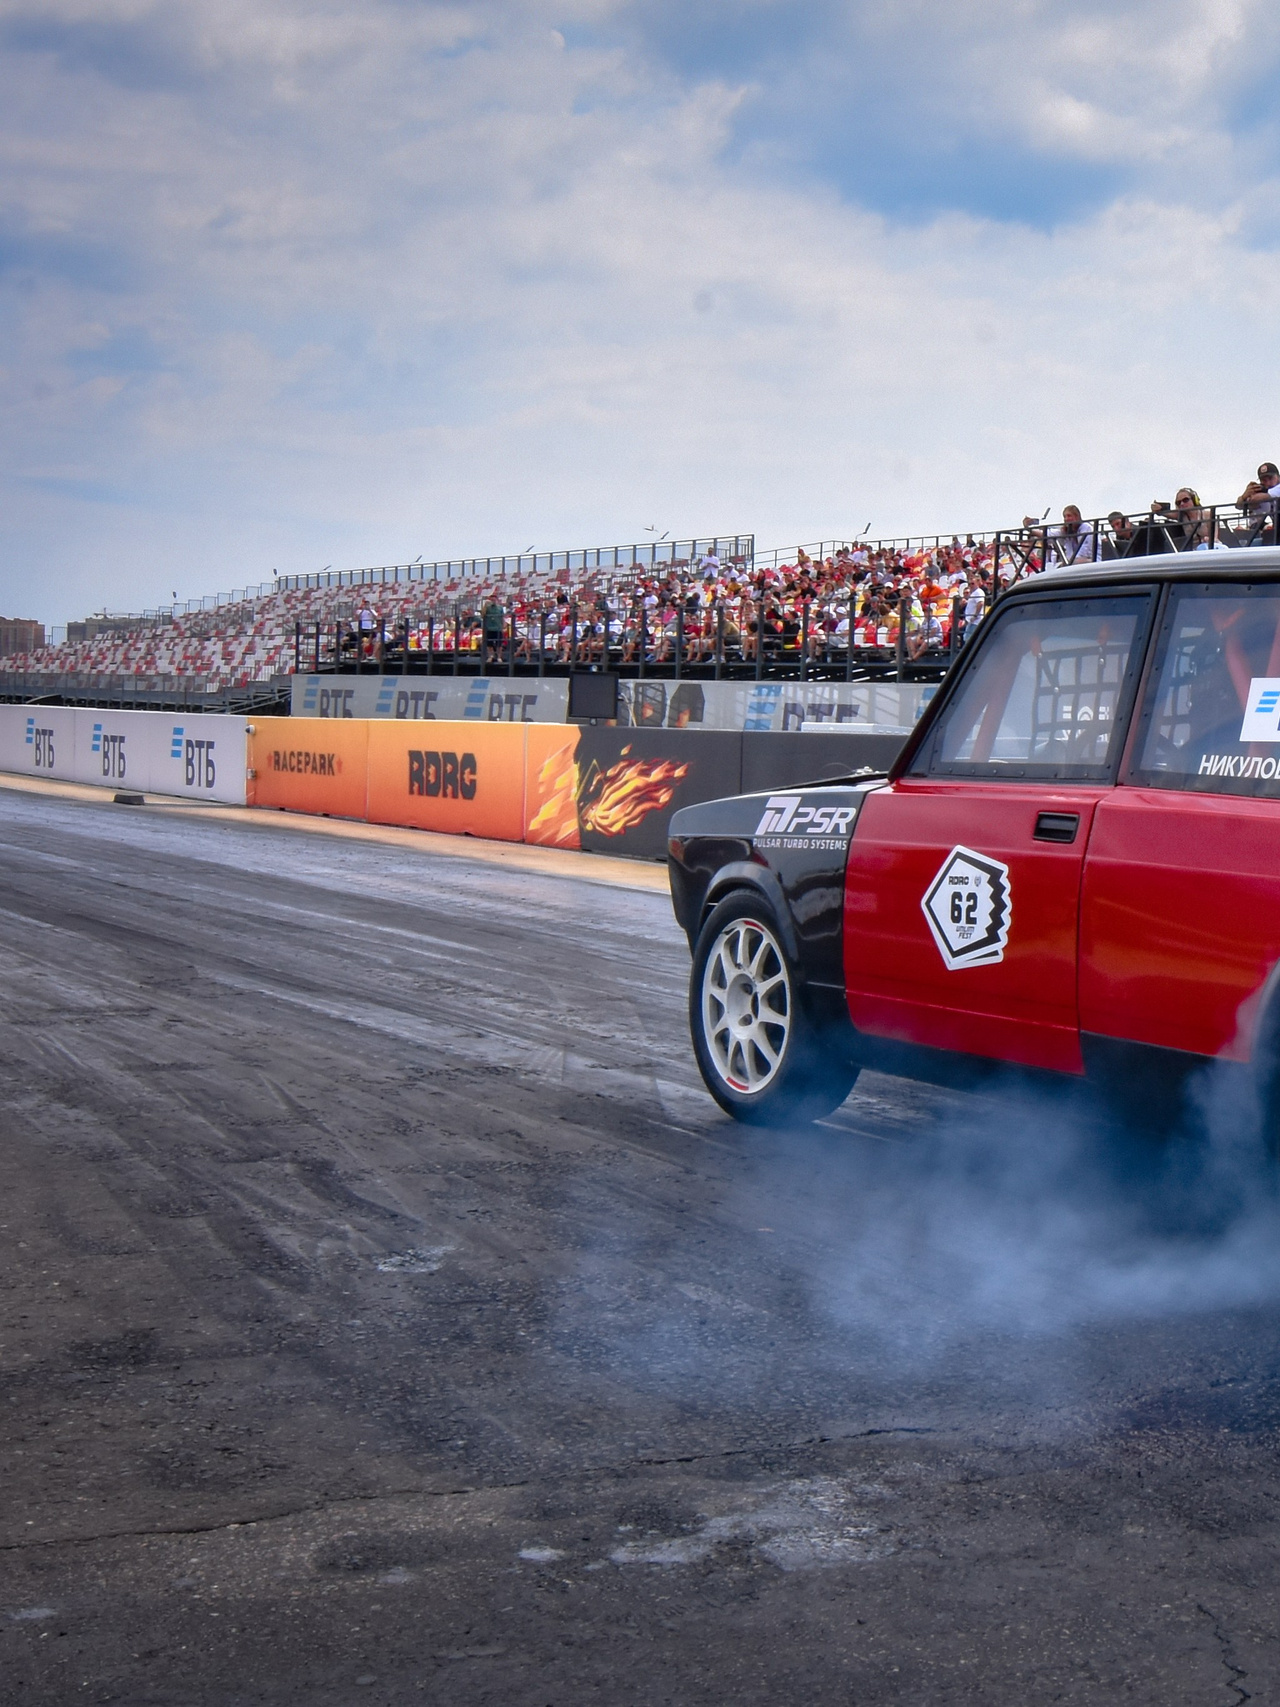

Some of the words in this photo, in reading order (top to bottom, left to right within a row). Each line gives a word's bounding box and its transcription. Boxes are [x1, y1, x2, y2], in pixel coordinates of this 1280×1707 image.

[35, 728, 55, 768] ВТБ
[103, 734, 126, 778] ВТБ
[185, 739, 216, 788] ВТБ
[273, 750, 336, 776] RACEPARK
[408, 750, 478, 800] RDRC
[787, 807, 857, 834] PSR
[752, 838, 781, 848] PULSAR
[783, 839, 809, 849] TURBO
[810, 840, 847, 851] SYSTEMS
[948, 875, 970, 886] RDRC
[950, 891, 978, 925] 62
